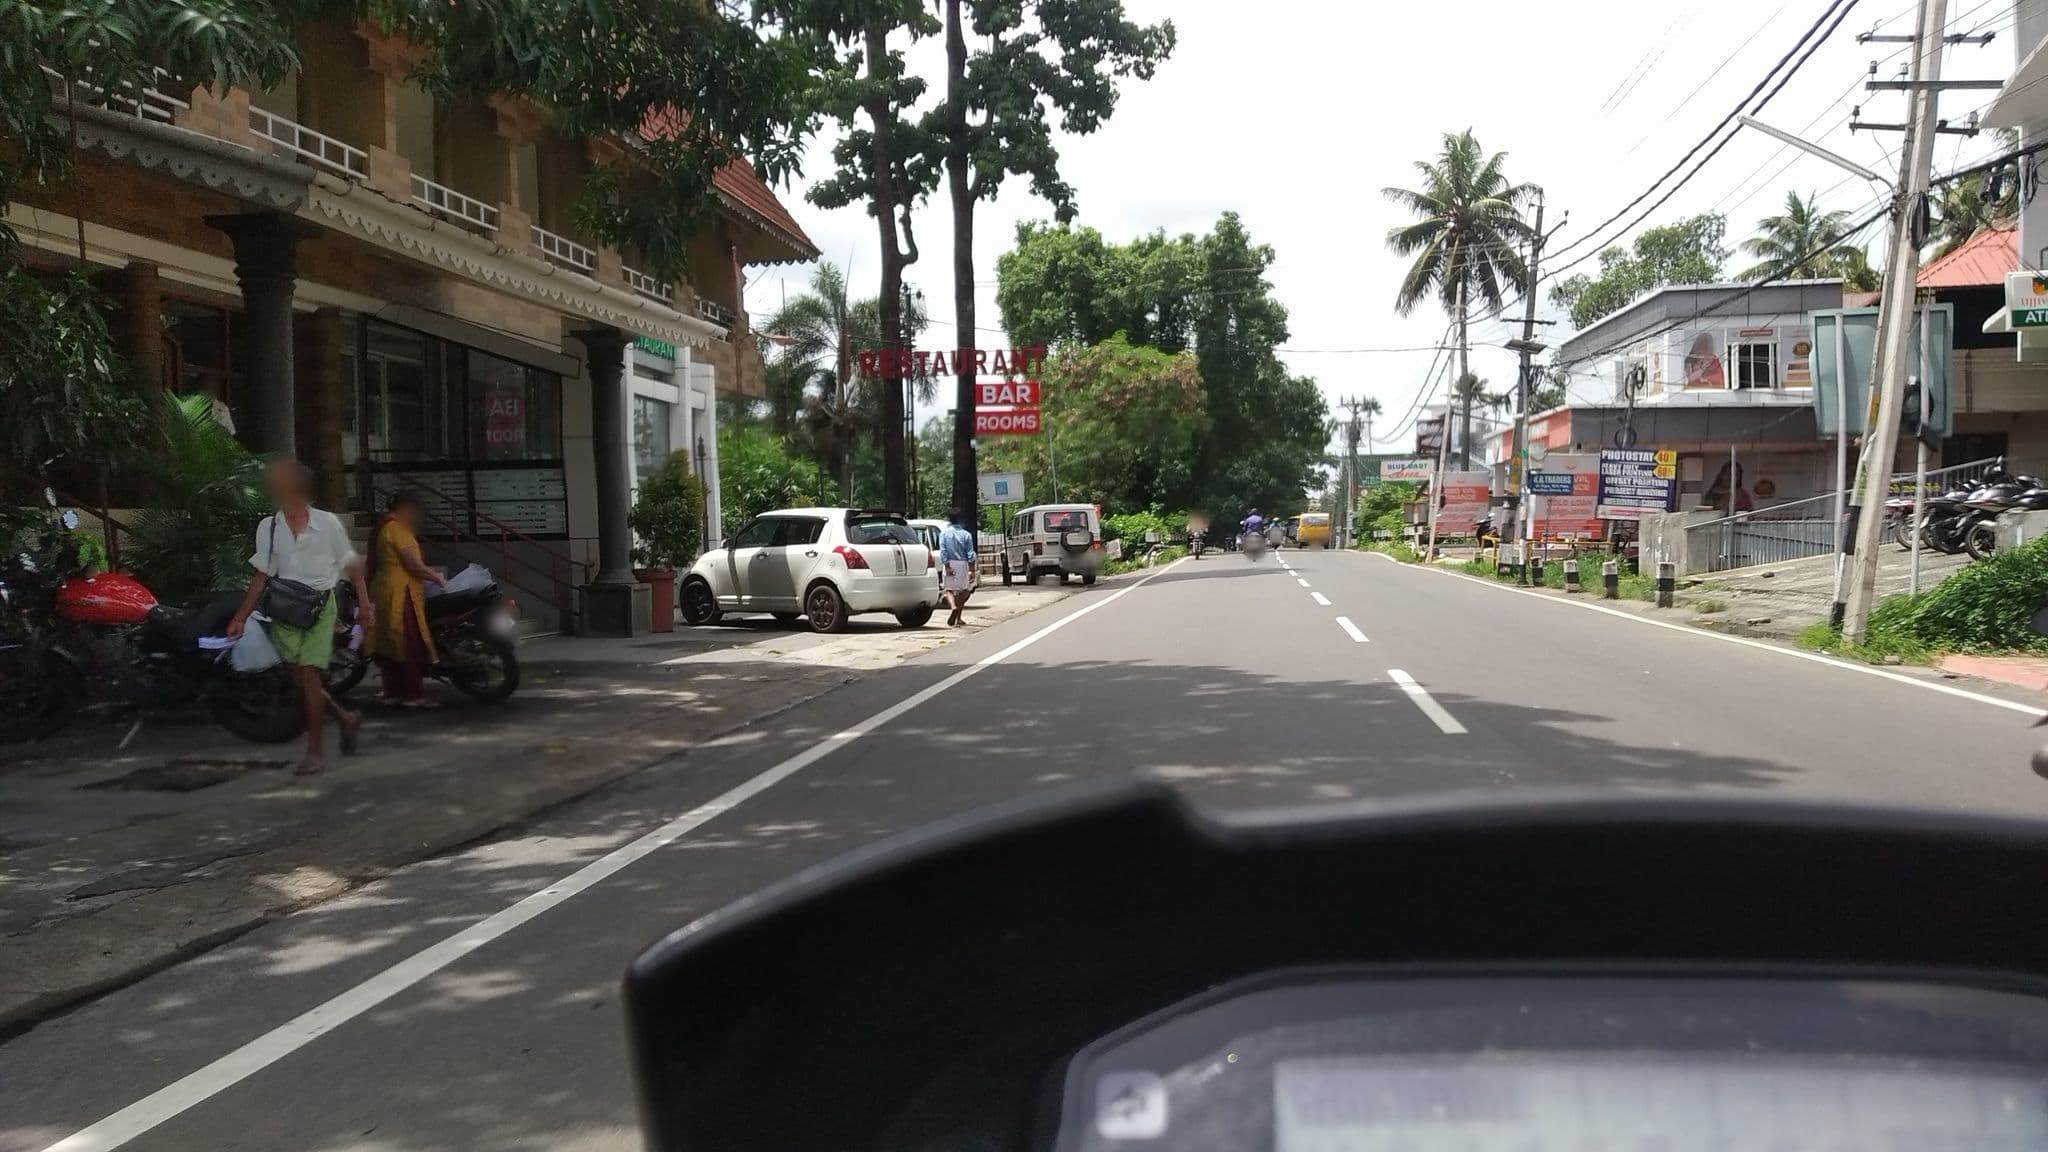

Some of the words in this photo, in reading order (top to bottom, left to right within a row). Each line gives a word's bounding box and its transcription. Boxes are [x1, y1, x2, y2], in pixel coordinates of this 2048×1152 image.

[2025, 311, 2048, 323] AT
[859, 346, 1047, 378] RESTAURANT
[981, 384, 1031, 404] BAR
[976, 415, 1037, 431] ROOMS
[1601, 450, 1654, 462] PHOTOSTAT
